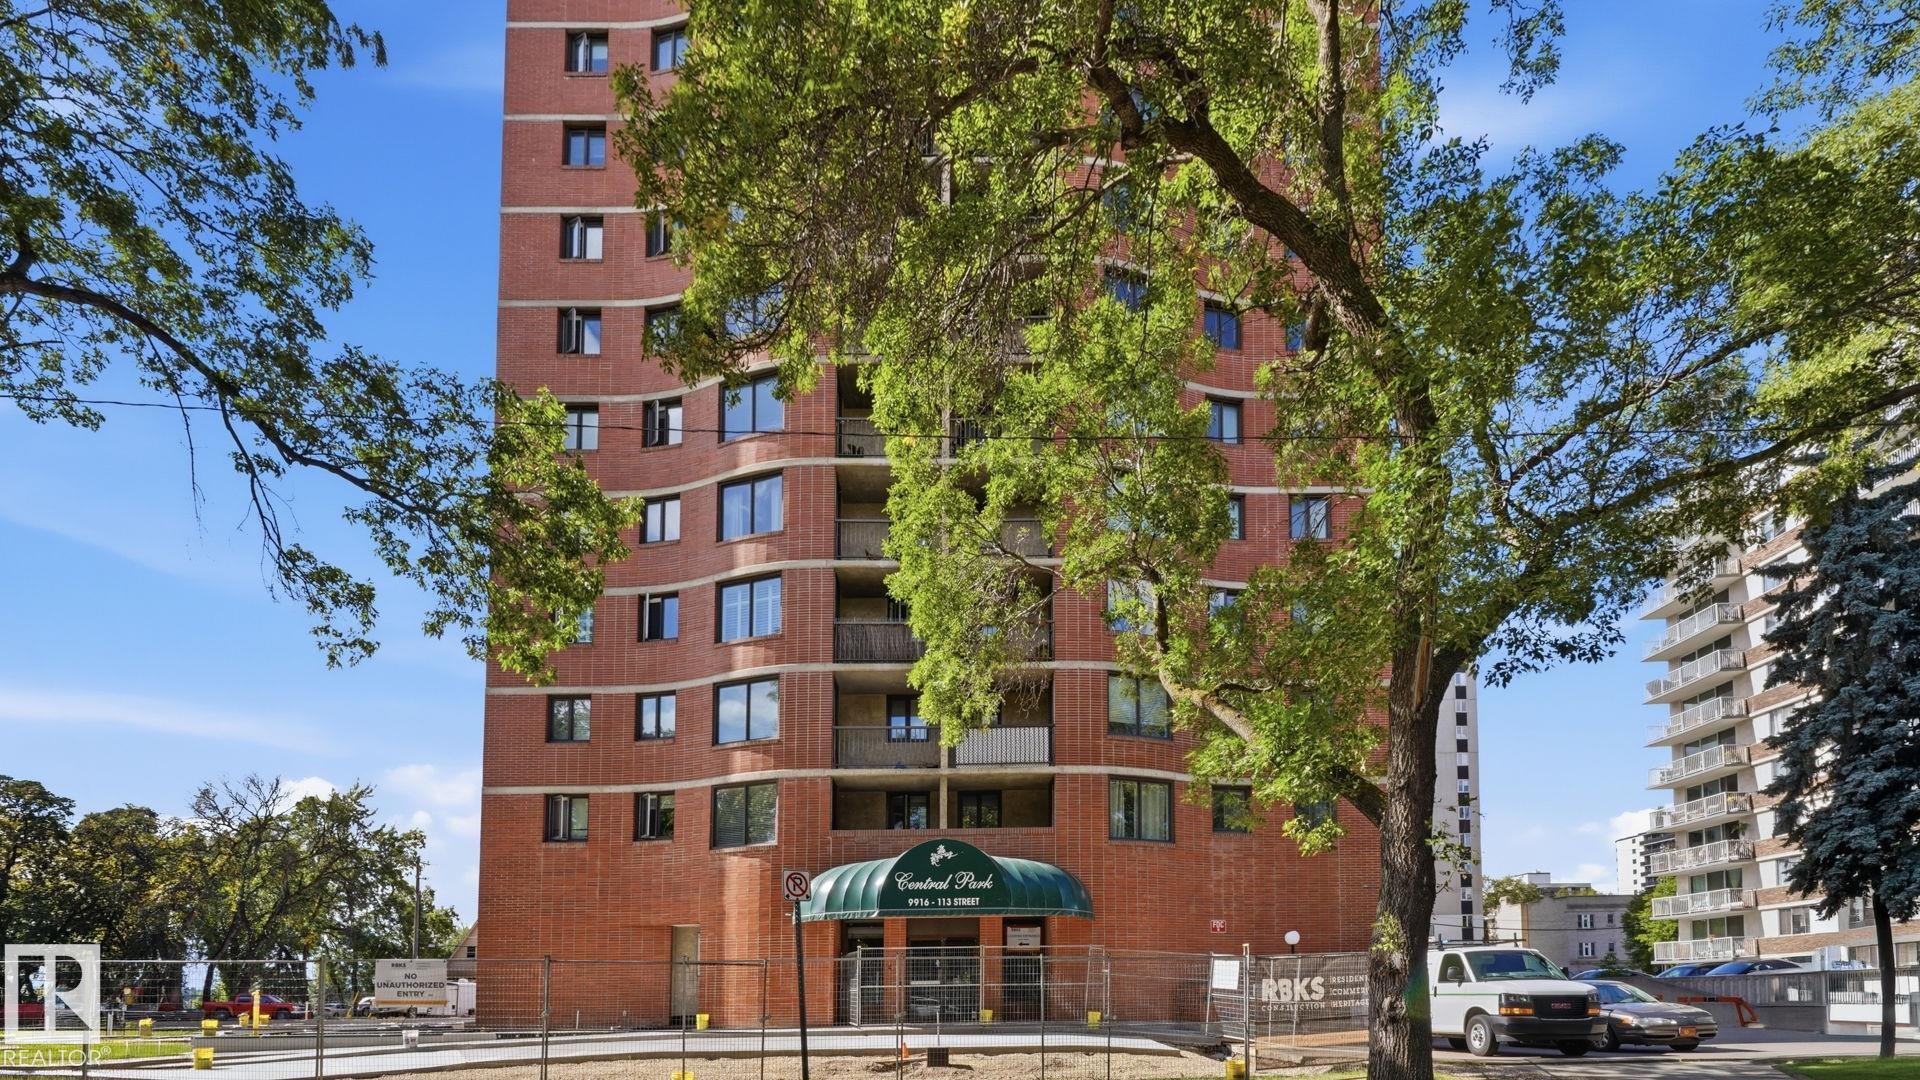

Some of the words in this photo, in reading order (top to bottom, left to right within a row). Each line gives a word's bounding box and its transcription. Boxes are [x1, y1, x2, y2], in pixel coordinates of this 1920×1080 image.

[895, 871, 953, 892] Central
[955, 871, 993, 890] Park
[908, 898, 930, 907] 9916
[938, 898, 952, 907] 113
[953, 898, 980, 906] STREET
[376, 981, 444, 989] UNAUTHORIZED
[1261, 976, 1325, 1001] RBKS
